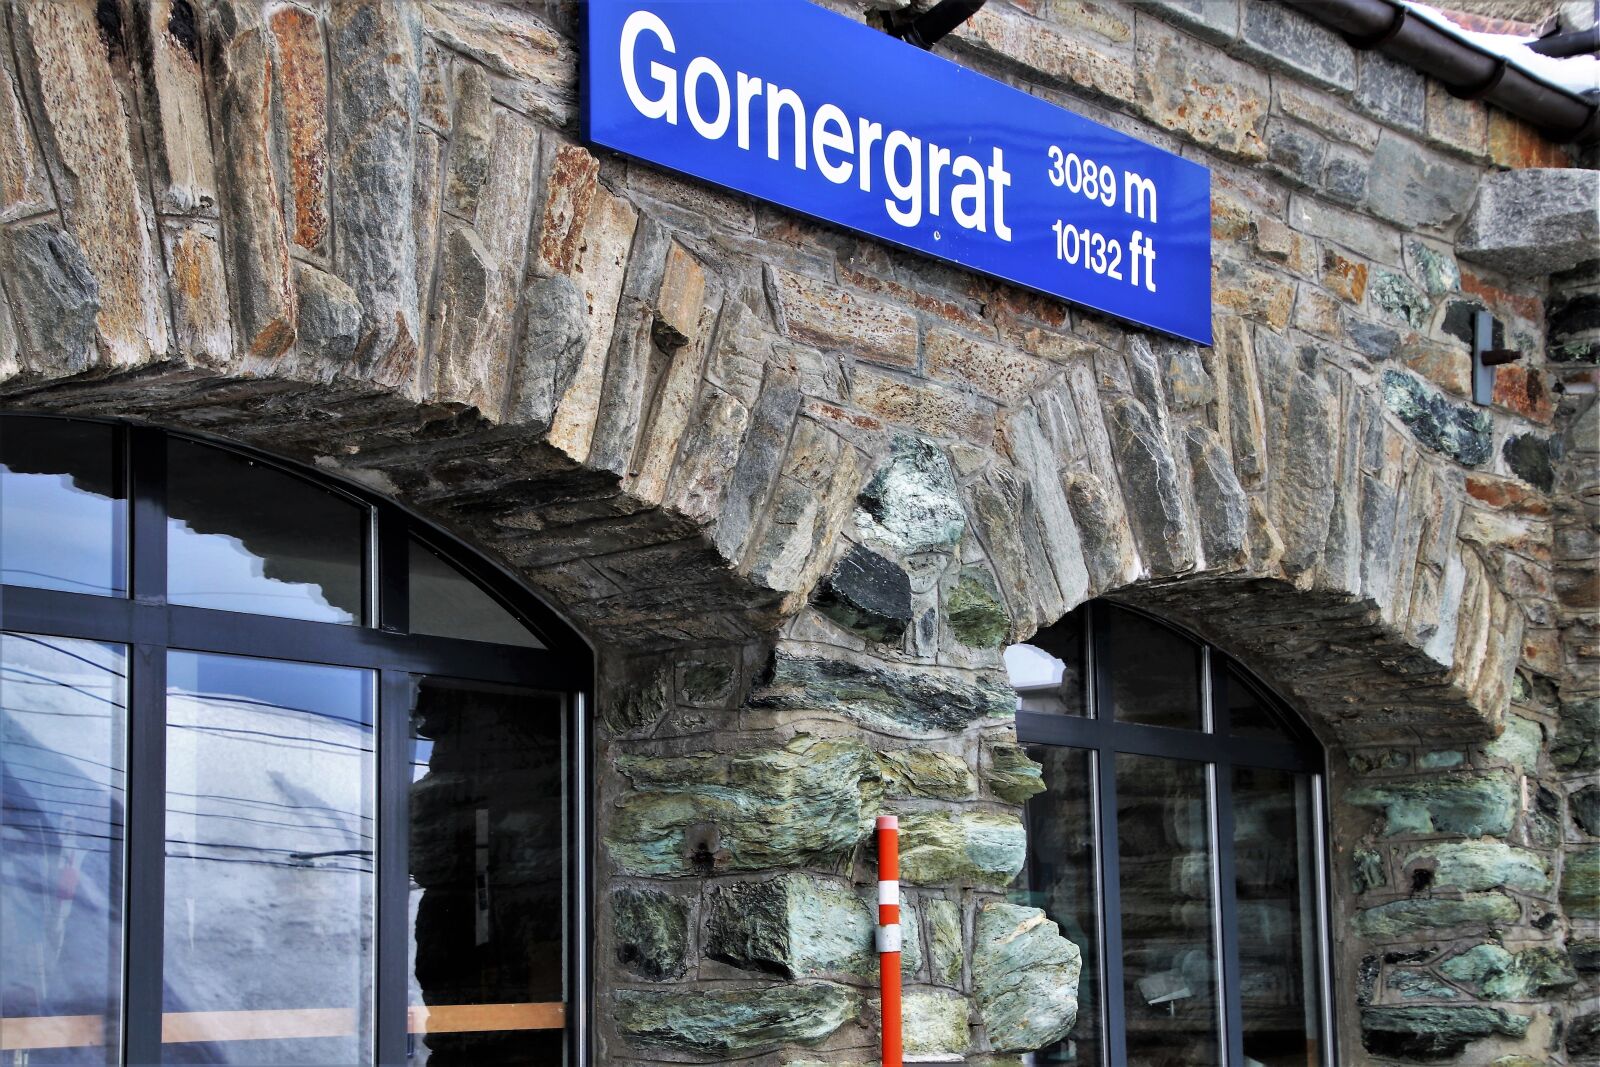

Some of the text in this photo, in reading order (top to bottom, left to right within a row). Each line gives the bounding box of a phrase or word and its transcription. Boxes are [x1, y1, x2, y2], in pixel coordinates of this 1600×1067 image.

[620, 10, 1012, 242] Gornergrat
[1048, 145, 1157, 224] 3089 m
[1052, 219, 1157, 293] 10132 ft
